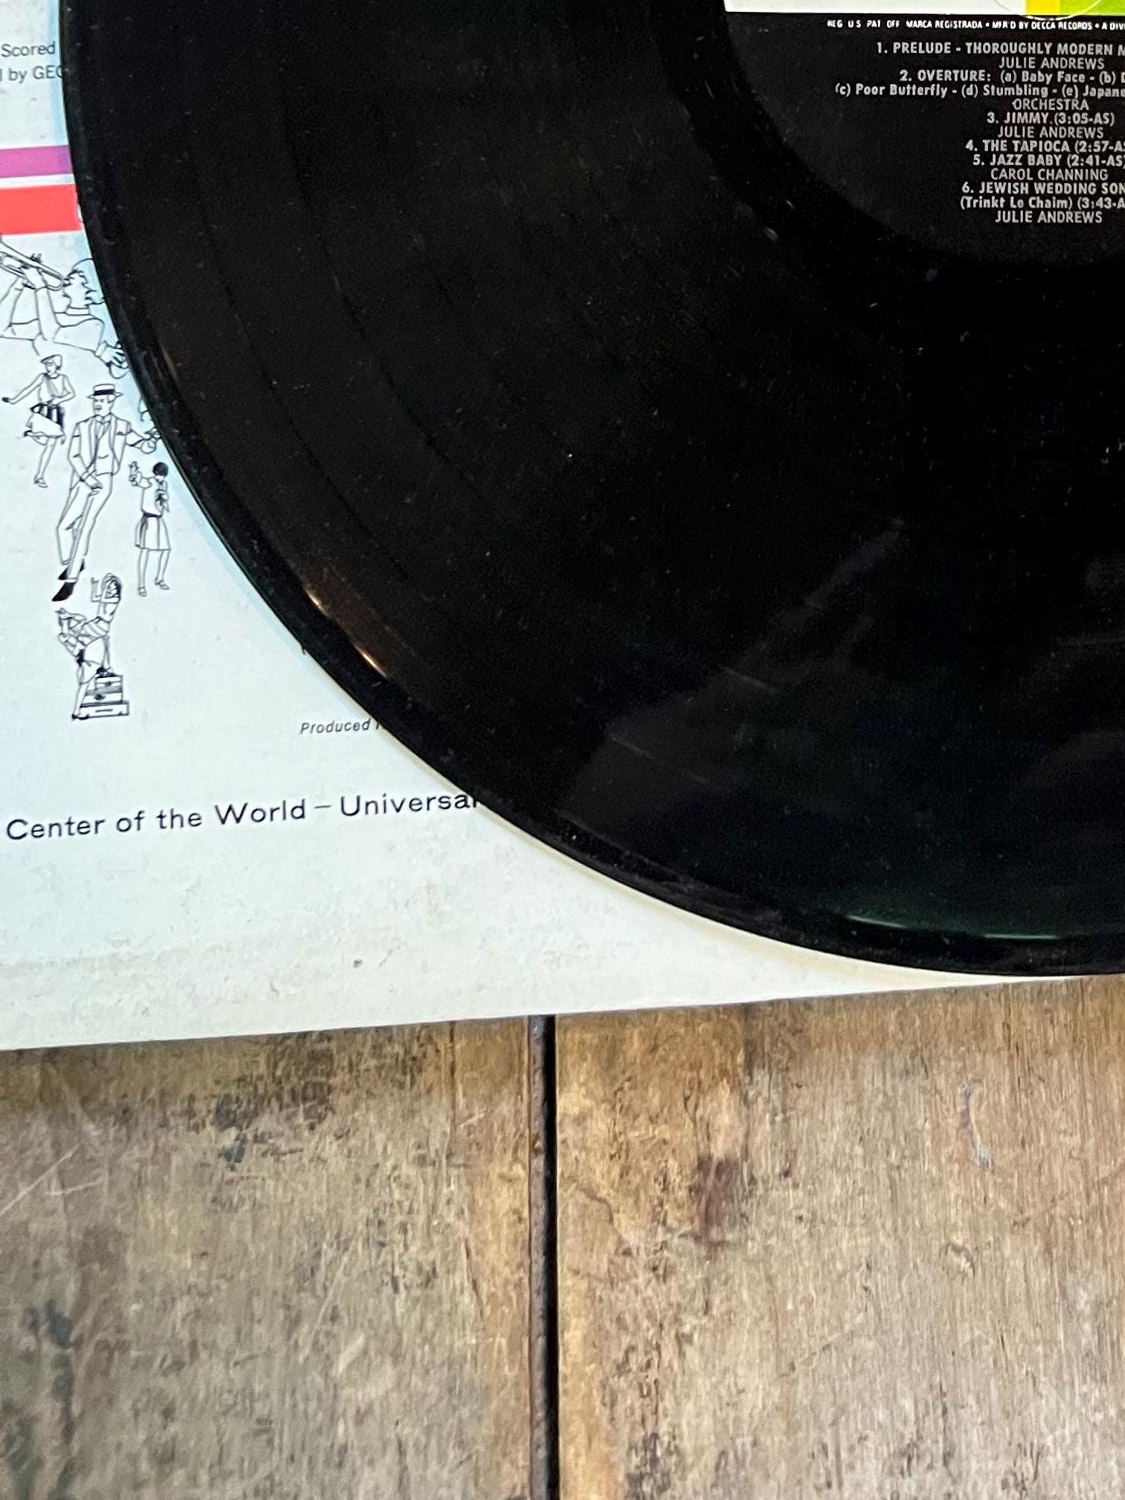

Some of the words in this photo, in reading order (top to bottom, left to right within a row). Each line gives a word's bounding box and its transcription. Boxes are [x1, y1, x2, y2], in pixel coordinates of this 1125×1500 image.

[906, 20, 932, 28] MARCA
[935, 20, 982, 29] REGISTRADA
[1019, 21, 1029, 29] BY
[1031, 21, 1056, 30] DECCA
[1058, 21, 1093, 30] RECORDS
[1102, 22, 1108, 30] A
[877, 42, 888, 54] 1.
[893, 42, 951, 54] PRELUDE
[965, 42, 1053, 55] THOROUGHLY
[1057, 43, 1113, 56] MODERN
[999, 57, 1036, 69] JULIE
[1040, 57, 1105, 69] ANDREWS
[900, 70, 912, 82] 2.
[917, 70, 991, 82] OVERTURE:
[1000, 71, 1017, 83] (a)
[1021, 71, 1052, 85] Baby
[1057, 72, 1086, 83] Face
[1099, 72, 1116, 84] (b)
[835, 83, 851, 97] (c)
[855, 84, 885, 96] Poor
[889, 84, 948, 99] Butterfly
[961, 85, 979, 98] (d)
[983, 84, 1048, 98] Stumbling
[1061, 86, 1079, 98] (e)
[1012, 99, 1089, 111] ORCHESTRA
[986, 112, 999, 124] 3.
[998, 126, 1035, 139] JULIE
[1039, 126, 1104, 139] ANDREWS
[965, 140, 978, 151] 4.
[982, 140, 1008, 152] THE
[1012, 140, 1070, 152] TAPIOCA
[972, 154, 985, 166] 5.
[989, 154, 1023, 166] JAZZ
[1027, 154, 1062, 166] BABY
[990, 168, 1034, 180] CAROL
[1037, 169, 1109, 181] CHANNING
[961, 182, 975, 194] 6.
[979, 182, 1029, 194] JEWISH
[1034, 182, 1097, 195] WEDDING
[960, 196, 1005, 210] (Trinkt
[1028, 197, 1073, 211] Chaim)
[995, 211, 1033, 223] JULIE
[1037, 211, 1103, 223] ANDREWS
[300, 717, 371, 734] Produced
[6, 816, 106, 840] Center
[116, 809, 146, 833] of
[156, 807, 203, 830] the
[214, 798, 306, 826] World
